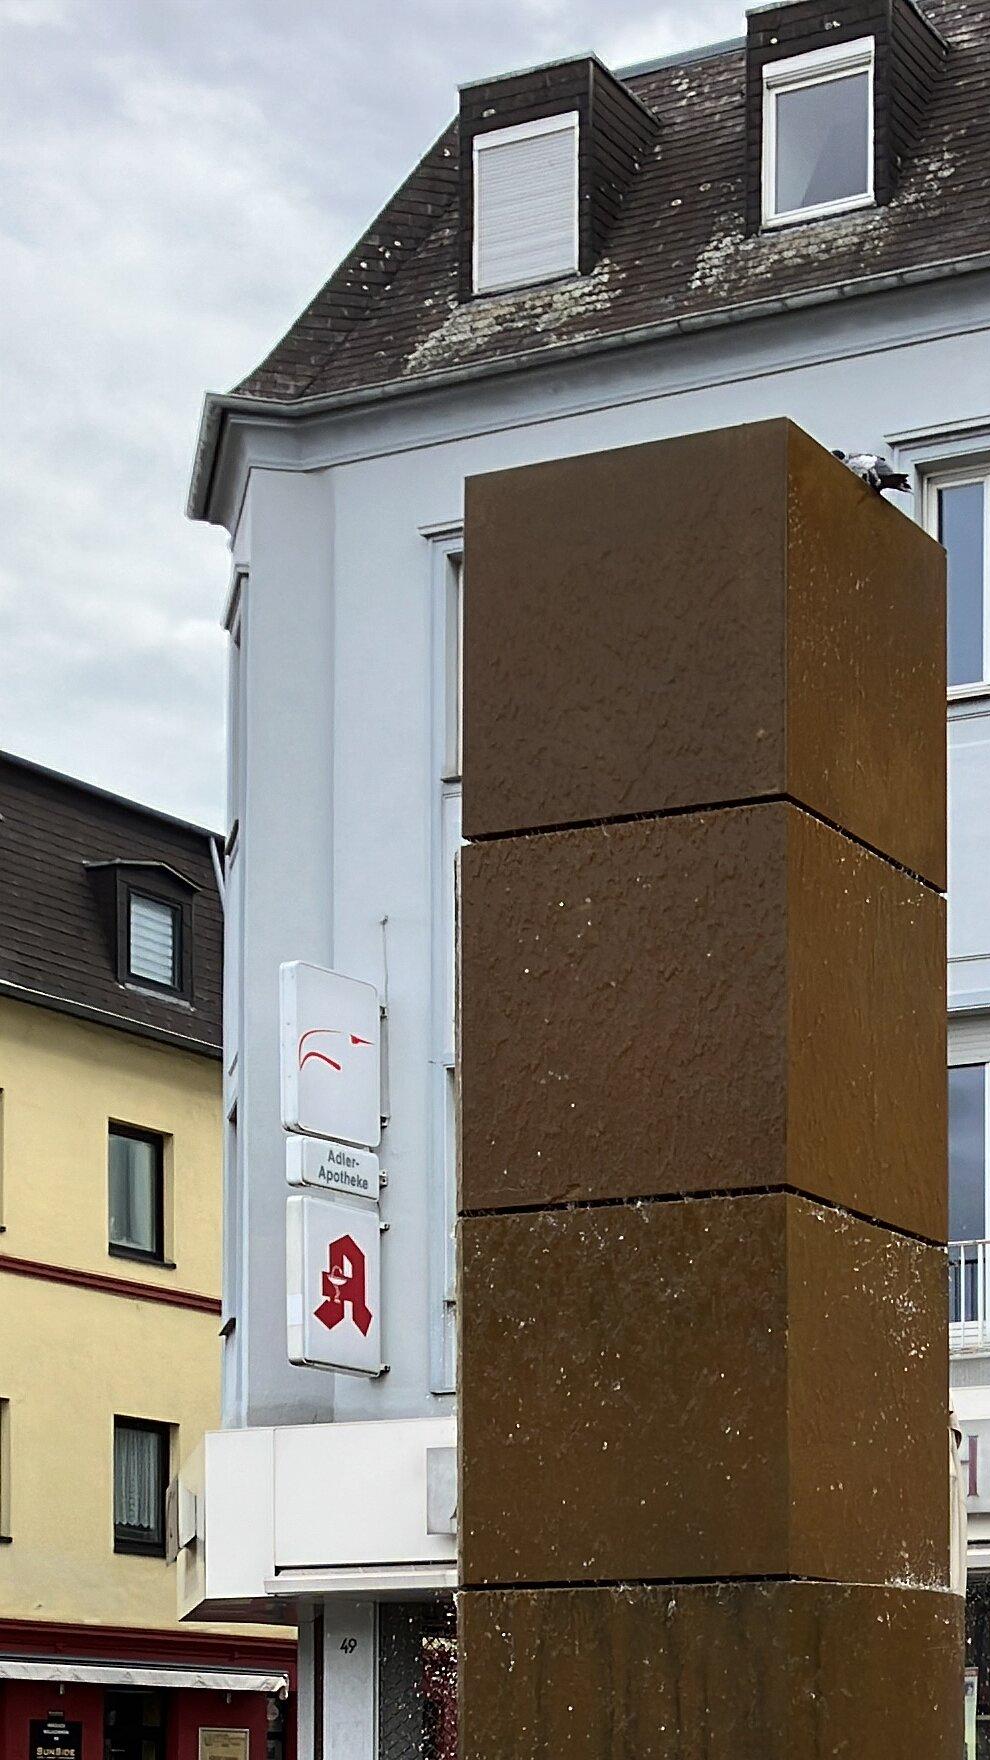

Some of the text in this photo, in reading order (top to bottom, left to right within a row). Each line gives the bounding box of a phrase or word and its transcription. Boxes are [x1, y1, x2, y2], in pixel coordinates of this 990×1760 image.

[328, 1150, 360, 1168] Adler-
[318, 1165, 369, 1190] Apotheke
[340, 1637, 358, 1654] 49
